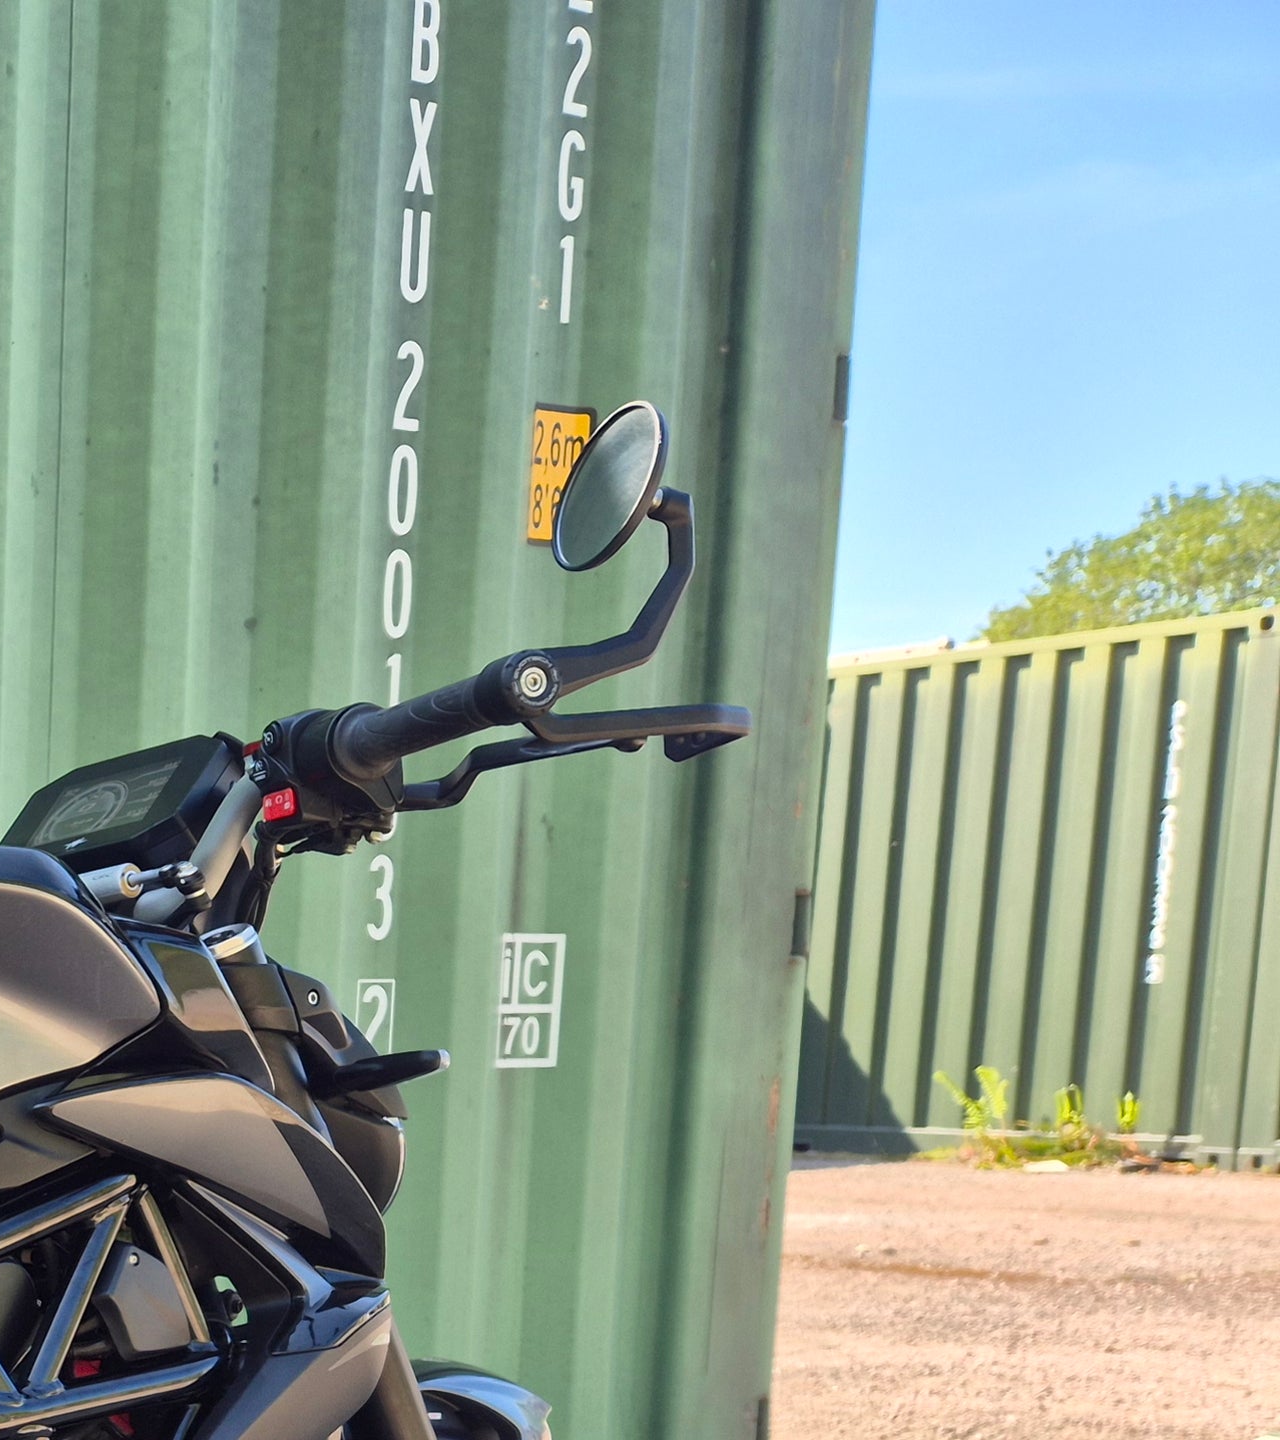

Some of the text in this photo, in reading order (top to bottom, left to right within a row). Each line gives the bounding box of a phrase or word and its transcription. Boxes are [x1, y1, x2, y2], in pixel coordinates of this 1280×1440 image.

[558, 0, 594, 324] 2G1
[532, 419, 587, 475] 2,6m
[366, 340, 425, 941] 20013
[501, 1015, 541, 1056] 70
